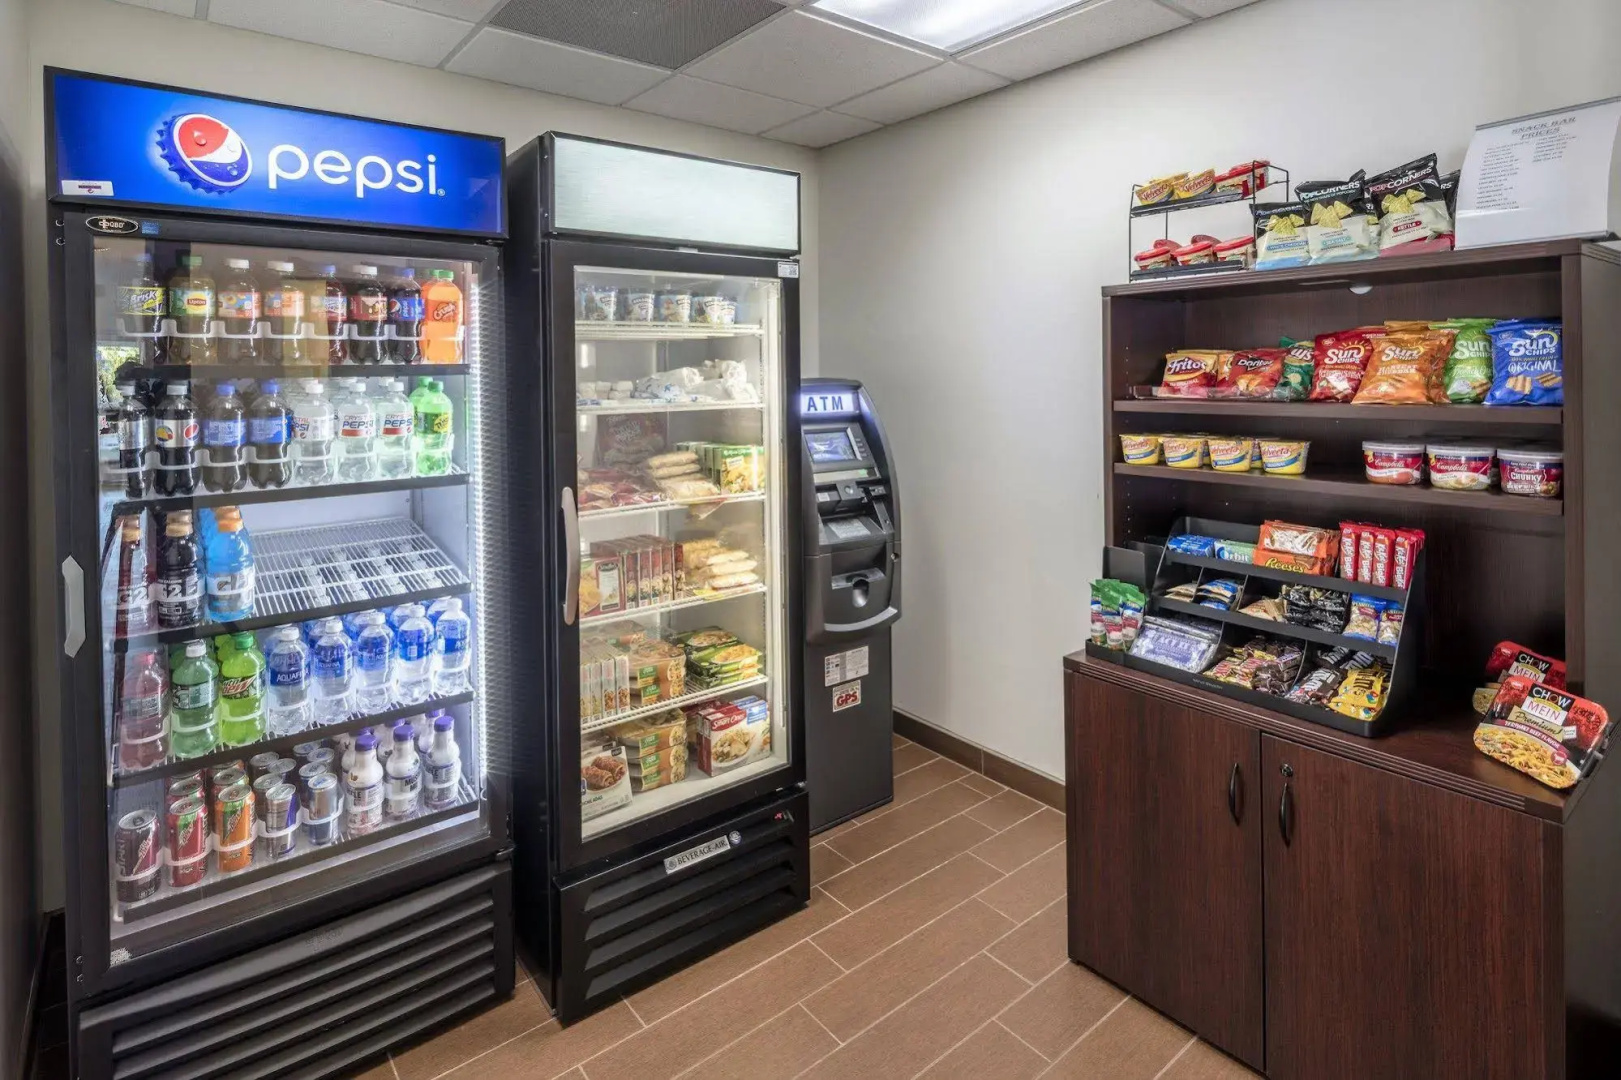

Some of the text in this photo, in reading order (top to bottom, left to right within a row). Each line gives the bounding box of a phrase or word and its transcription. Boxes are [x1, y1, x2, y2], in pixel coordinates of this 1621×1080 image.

[268, 143, 438, 199] pepsi
[1324, 348, 1361, 365] Sun
[1382, 346, 1420, 361] Sun
[1525, 347, 1556, 356] CHIPS
[807, 396, 844, 412] ATM
[384, 420, 412, 429] PEPS
[1510, 471, 1542, 482] CHUNKY
[1217, 546, 1250, 562] Orbit
[1518, 653, 1550, 671] CHOW
[1513, 665, 1541, 682] MEIN
[836, 691, 858, 707] GPS
[1532, 686, 1572, 708] CHOW
[1527, 700, 1561, 721] MEIN
[1515, 710, 1563, 735] Premium
